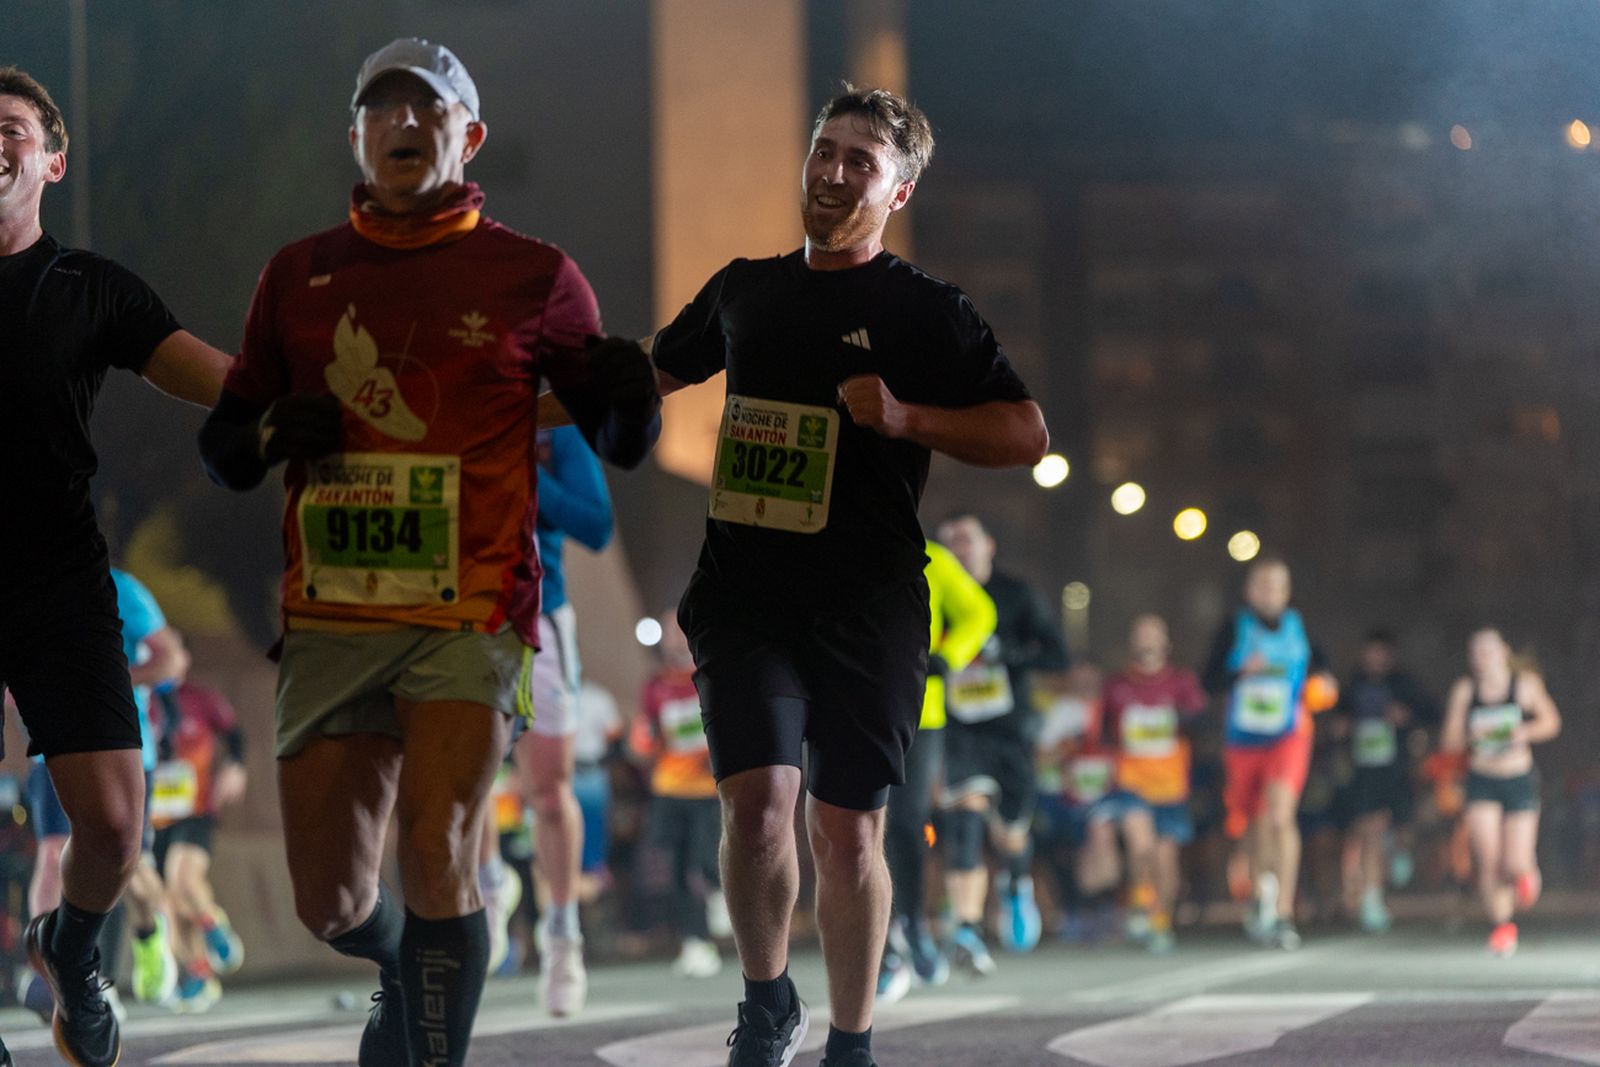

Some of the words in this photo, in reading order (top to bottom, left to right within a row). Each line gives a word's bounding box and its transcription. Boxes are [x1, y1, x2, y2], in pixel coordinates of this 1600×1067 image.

[352, 378, 394, 418] 43
[741, 411, 773, 428] NOCHE
[774, 415, 789, 429] DE
[732, 443, 808, 488] 3022
[327, 509, 422, 553] 9134
